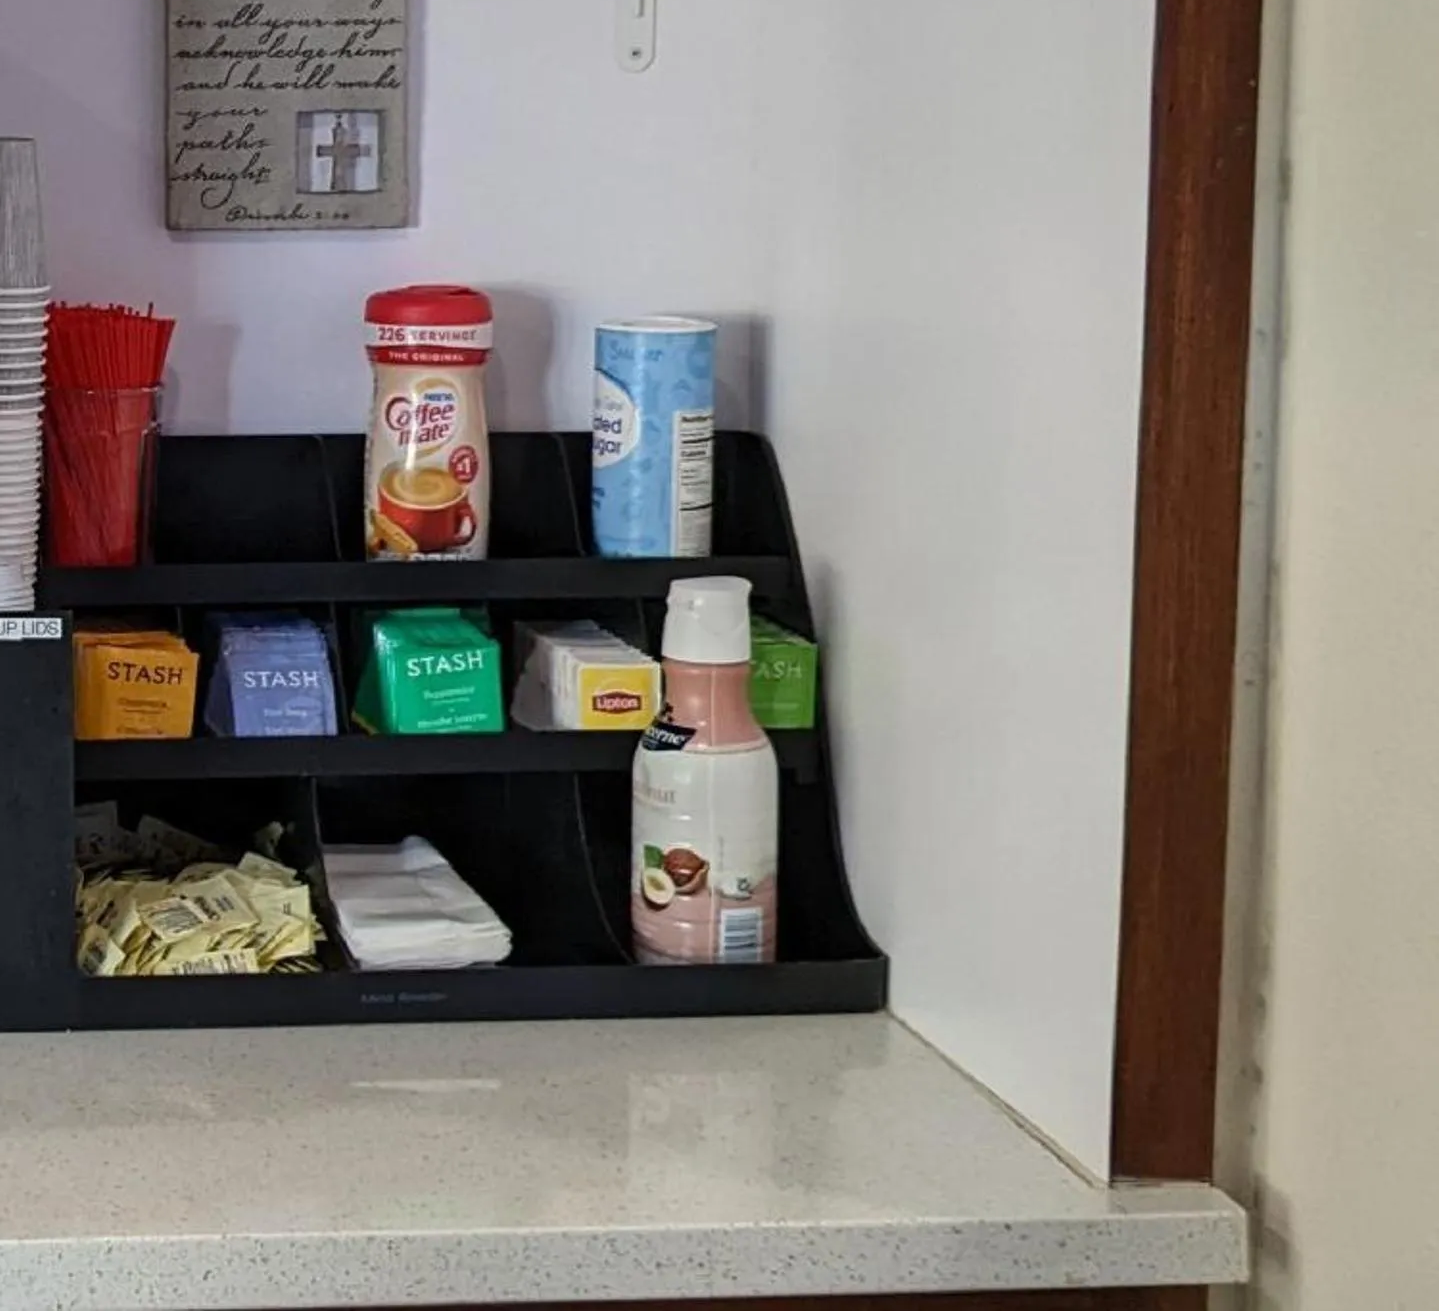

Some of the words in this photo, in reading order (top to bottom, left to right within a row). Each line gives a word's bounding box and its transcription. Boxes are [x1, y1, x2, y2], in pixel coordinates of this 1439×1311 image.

[175, 15, 207, 29] in
[213, 3, 264, 29] all
[259, 19, 332, 45] your
[334, 18, 402, 40] ways
[172, 32, 332, 73] acknowledge
[331, 32, 404, 59] him
[175, 60, 240, 90] and
[232, 63, 270, 90] he
[269, 63, 336, 90] will
[334, 64, 401, 90] make
[175, 107, 269, 130] your
[174, 122, 273, 165] paths
[377, 326, 406, 342] 226
[388, 350, 409, 361] THE
[411, 351, 465, 362] ORIGINAL
[21, 621, 60, 638] LIDS
[106, 660, 185, 686] STASH
[406, 651, 485, 678] STASH
[751, 659, 803, 680] ASH
[243, 670, 319, 689] STASH
[594, 696, 639, 712] Lipton
